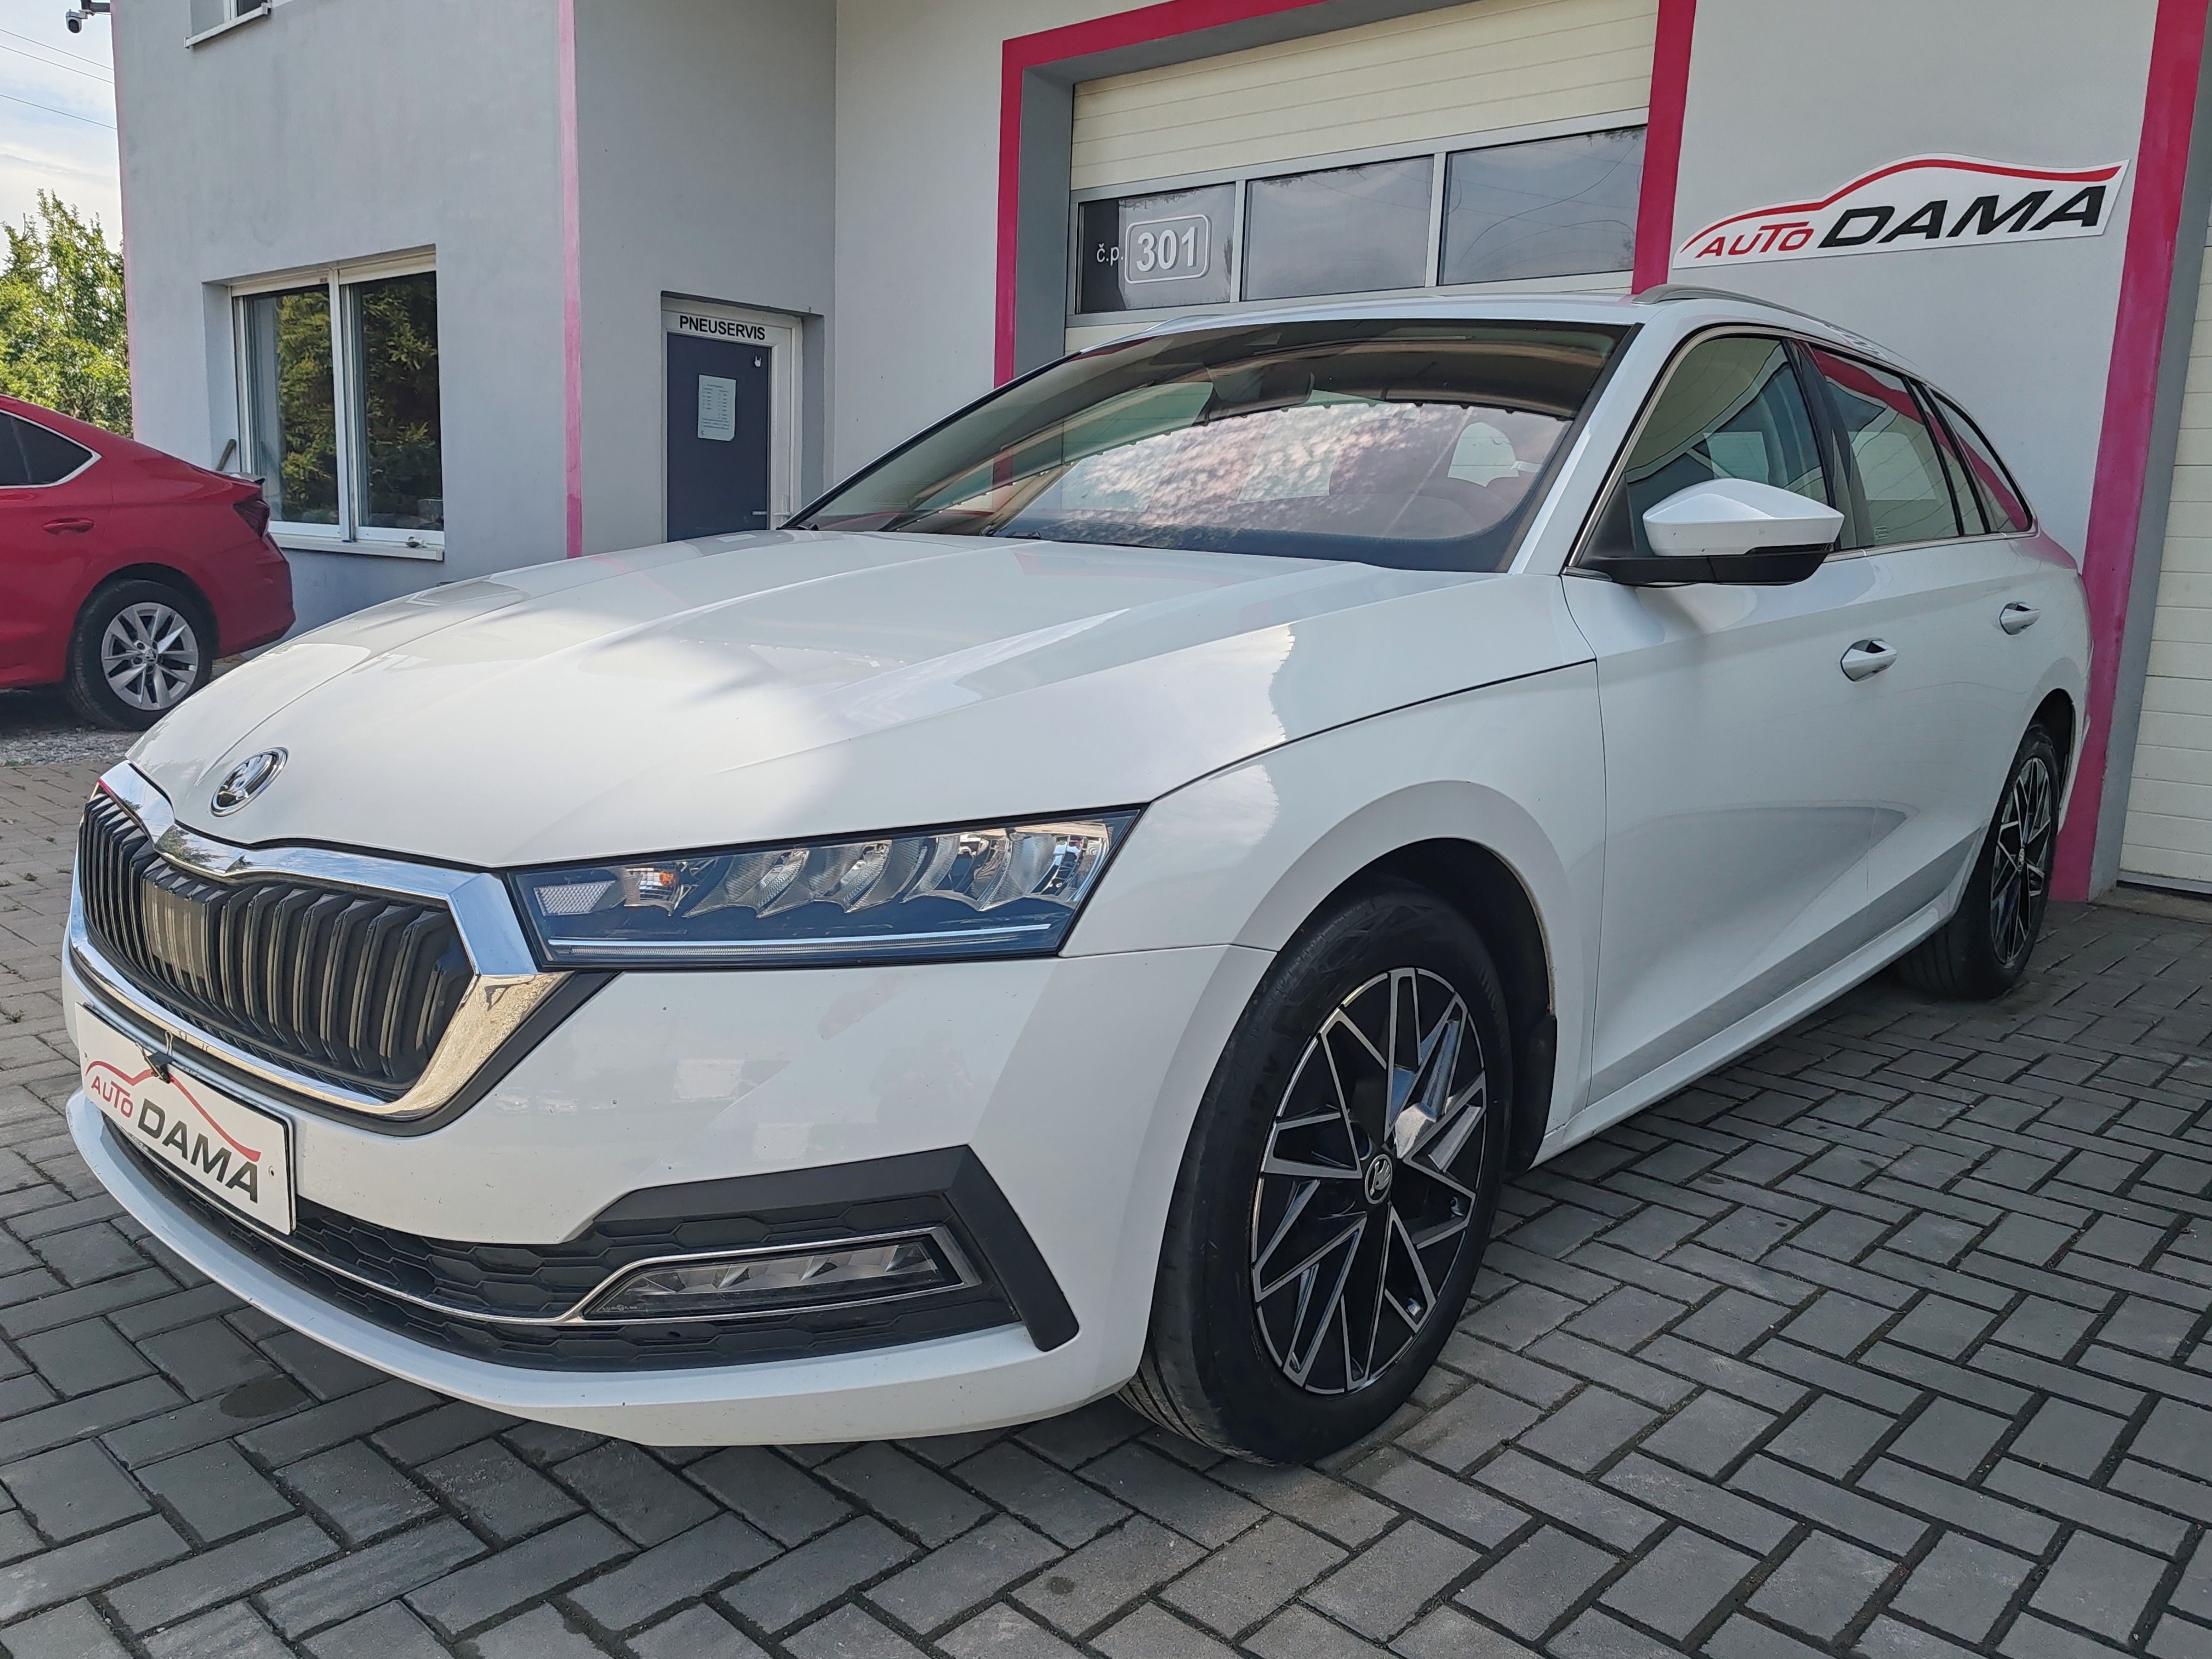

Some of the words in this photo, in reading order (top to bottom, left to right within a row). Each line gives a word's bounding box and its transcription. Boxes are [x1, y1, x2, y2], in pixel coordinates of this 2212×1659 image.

[1096, 243, 1123, 266] č.p.
[1136, 226, 1196, 272] 301
[1695, 220, 1815, 259] AUTO
[1817, 185, 2107, 249] DAMA
[679, 315, 765, 340] PNEUSERVIS
[91, 1075, 133, 1118] AUTO
[137, 1098, 259, 1204] DAMA
